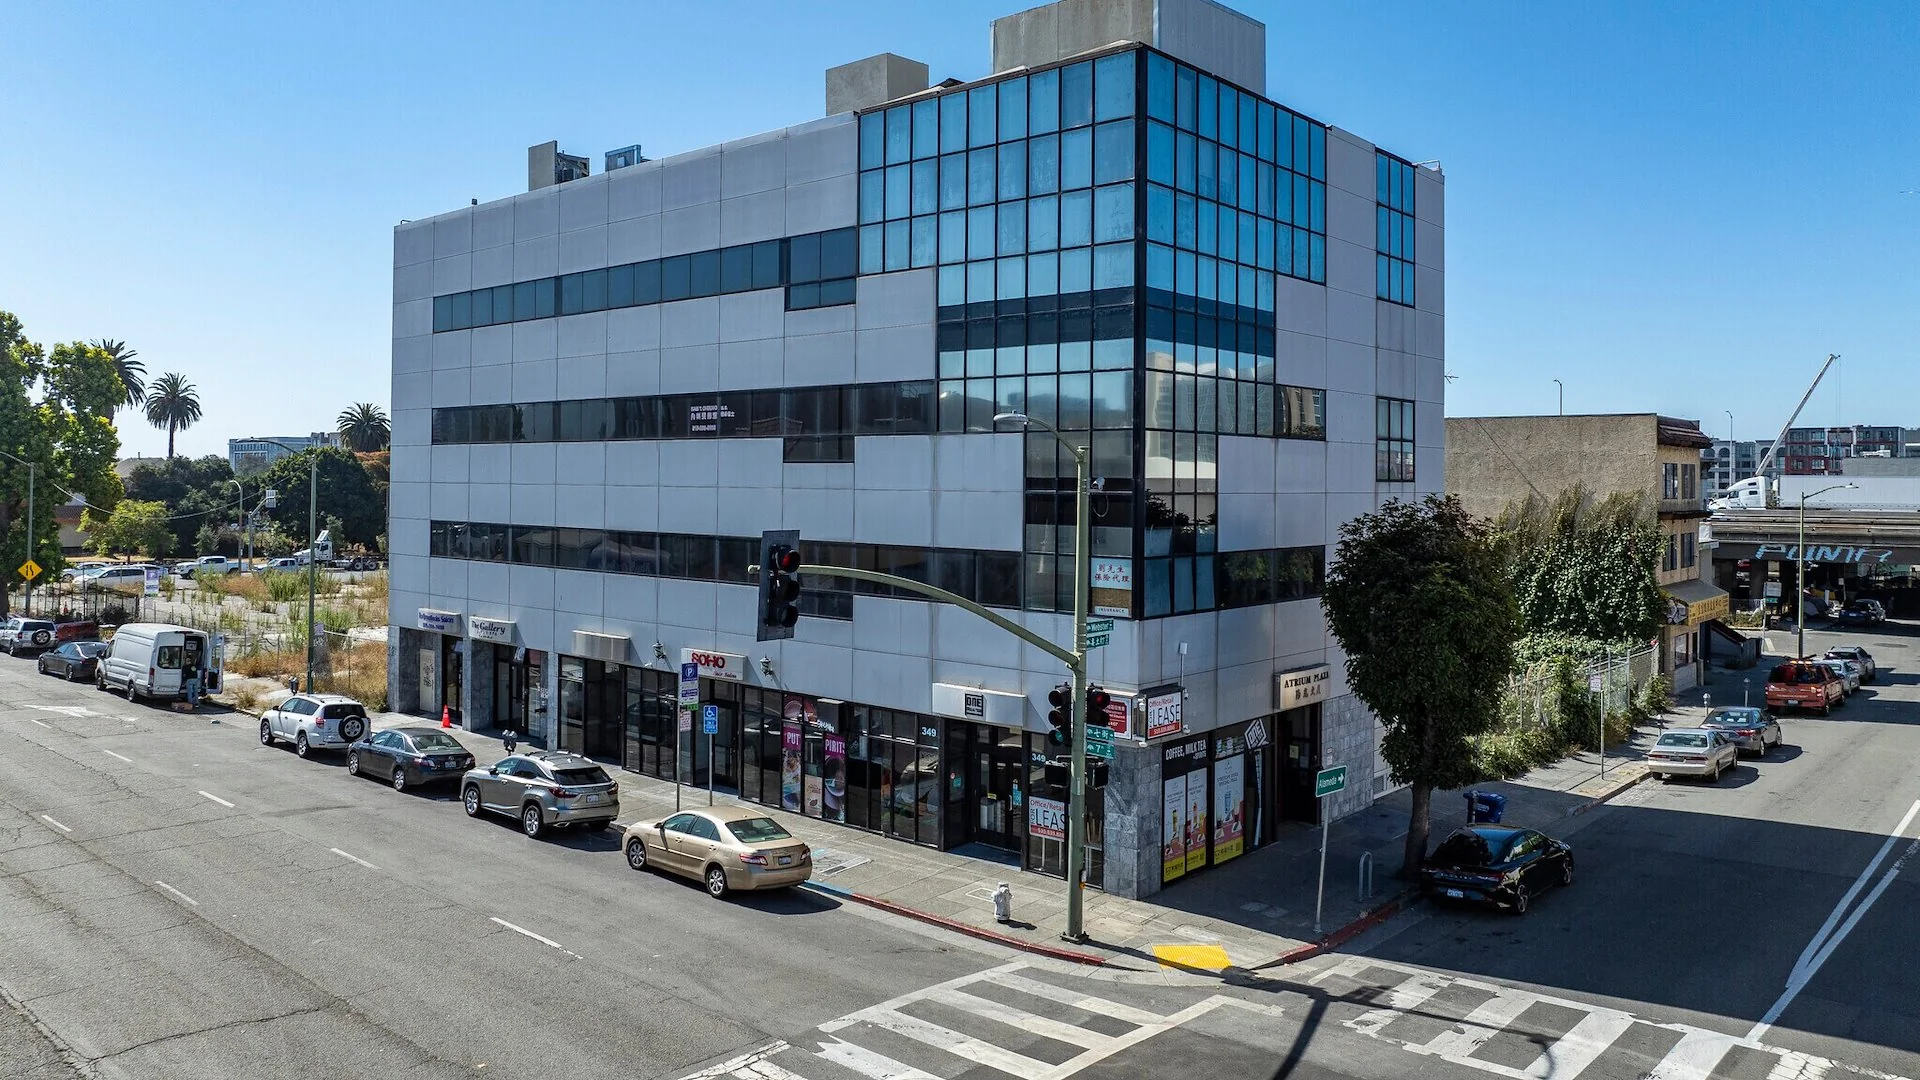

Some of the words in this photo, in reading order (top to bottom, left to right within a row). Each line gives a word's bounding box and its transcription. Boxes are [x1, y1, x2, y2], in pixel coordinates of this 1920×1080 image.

[480, 621, 505, 634] Gallery
[1091, 622, 1109, 632] Webster
[691, 652, 725, 668] SOHO
[1284, 674, 1311, 689] ATRIUM
[1313, 671, 1329, 682] PLAZA
[966, 697, 982, 707] ONE
[1153, 703, 1180, 727] LEASE
[786, 731, 800, 746] PUT
[921, 726, 937, 737] 349
[1165, 745, 1185, 760] COFFEE,
[1185, 741, 1197, 755] MILK
[1197, 739, 1207, 751] TEA
[1031, 753, 1046, 763] 349
[1318, 774, 1337, 788] Alameda
